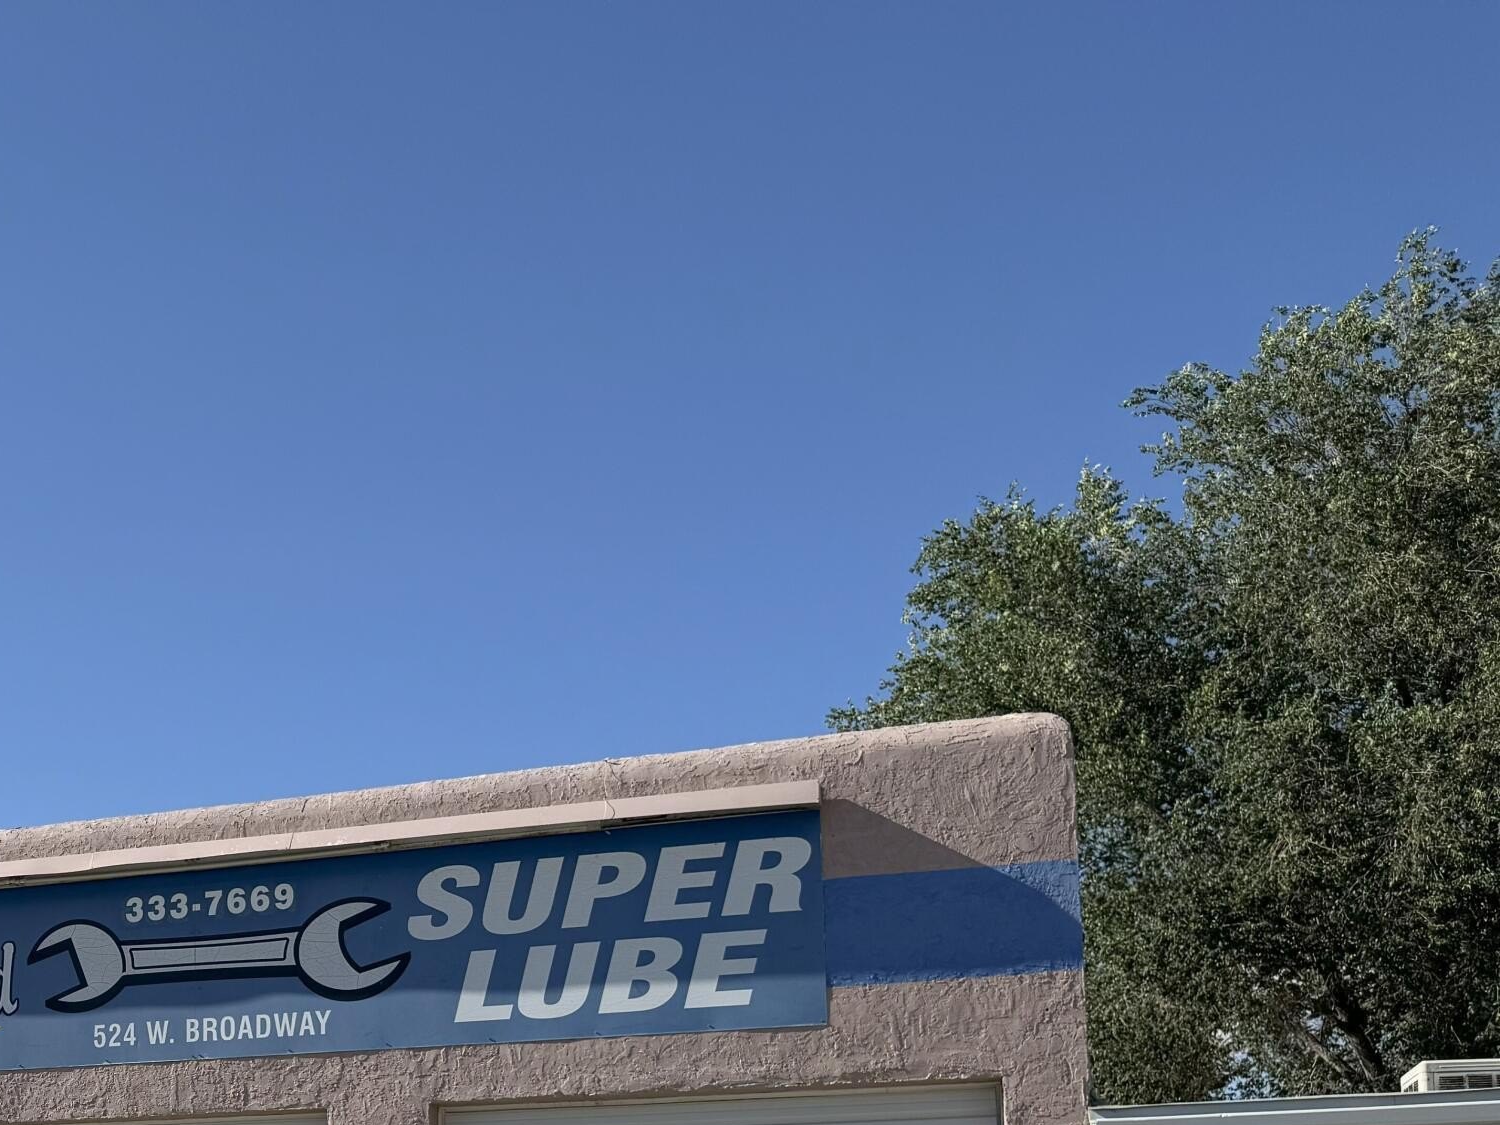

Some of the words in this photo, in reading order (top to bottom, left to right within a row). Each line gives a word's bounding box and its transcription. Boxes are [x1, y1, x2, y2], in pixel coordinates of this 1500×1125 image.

[125, 883, 294, 923] 333-7669
[407, 836, 812, 941] SUPER
[453, 929, 768, 1023] LUBE
[93, 1022, 137, 1048] 524
[146, 1020, 175, 1045] W.
[185, 1010, 332, 1043] BROADWAY
